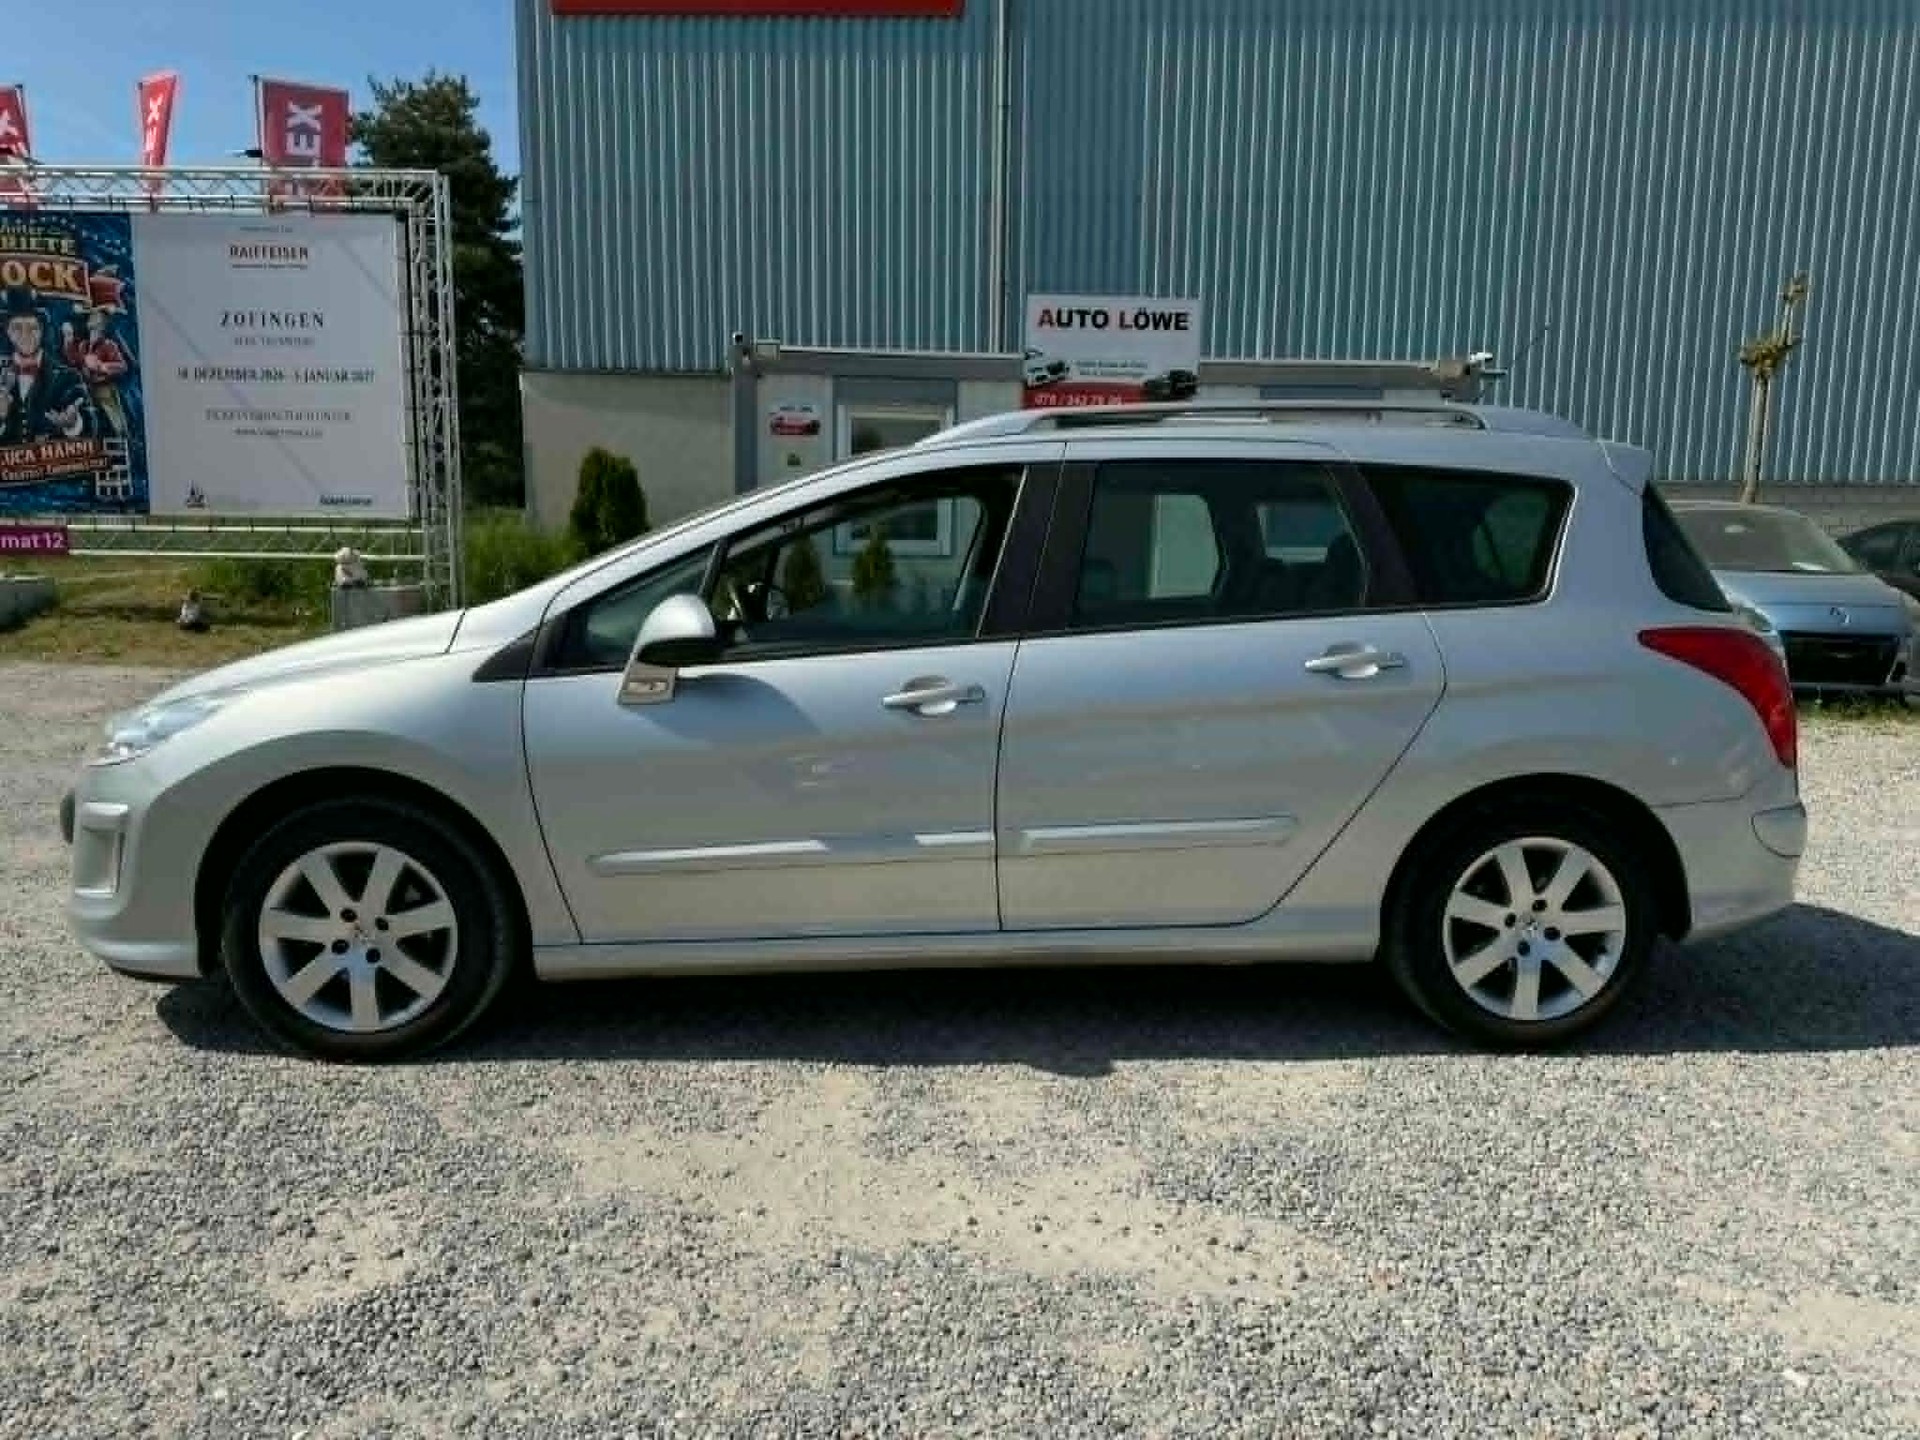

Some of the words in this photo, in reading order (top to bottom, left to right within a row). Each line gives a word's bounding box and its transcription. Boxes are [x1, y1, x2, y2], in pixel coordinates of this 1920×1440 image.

[219, 310, 324, 328] ZOFINGEN
[1038, 308, 1109, 329] AUTO
[1118, 307, 1190, 330] LÖWE
[43, 531, 64, 549] 12
